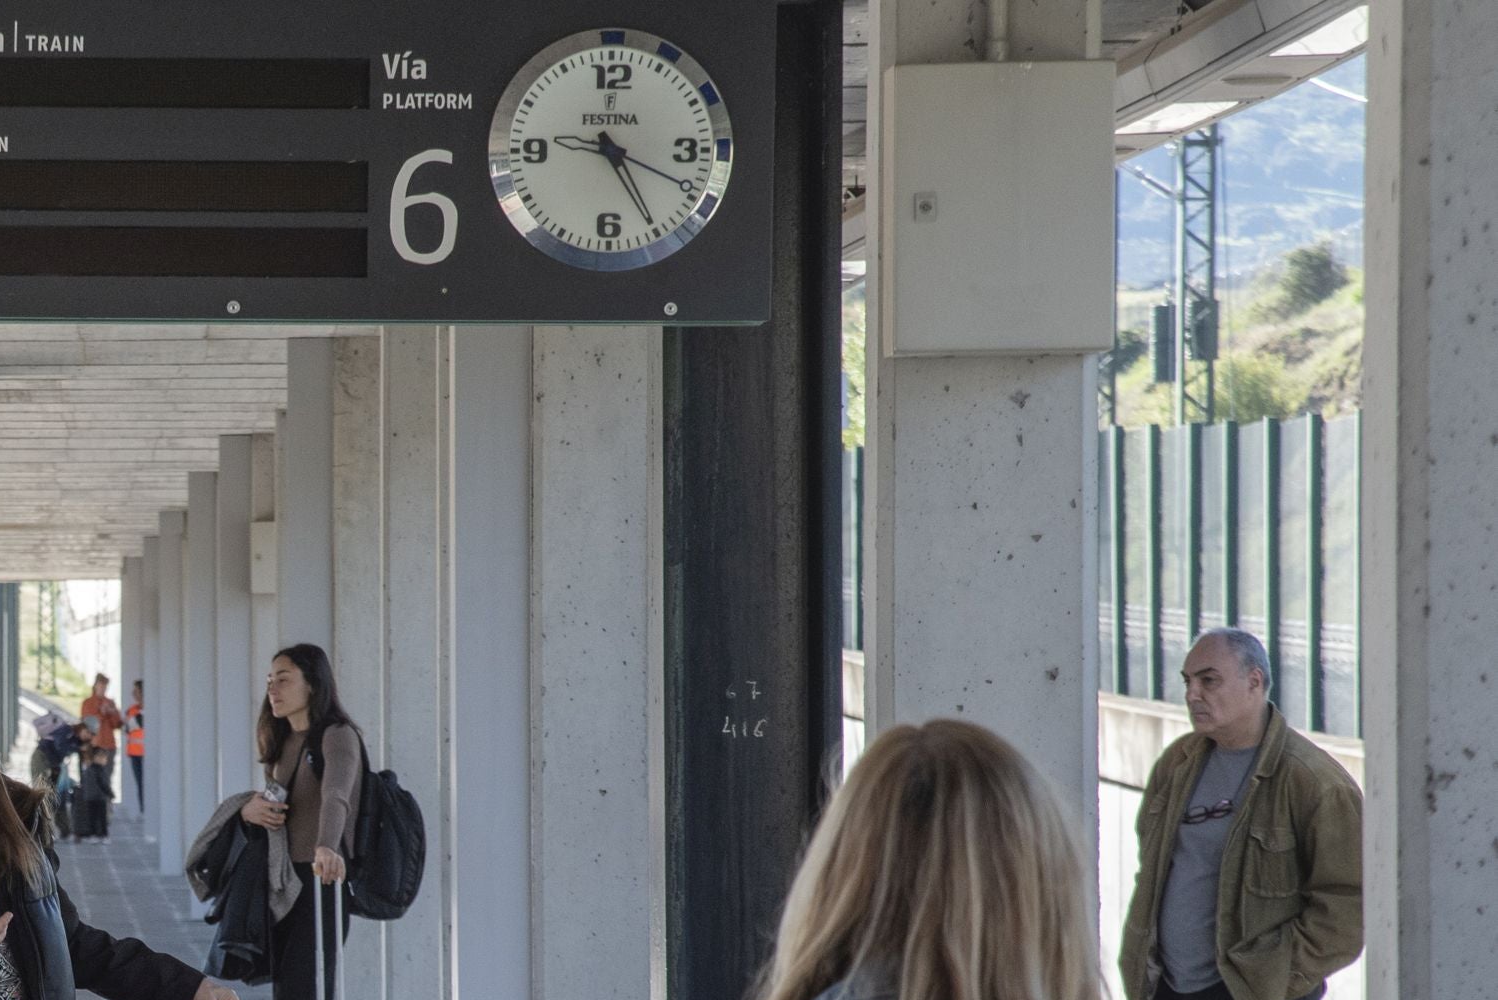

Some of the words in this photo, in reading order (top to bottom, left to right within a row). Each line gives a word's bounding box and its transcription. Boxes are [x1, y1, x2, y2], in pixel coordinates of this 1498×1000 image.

[25, 34, 84, 52] TRAIN
[382, 50, 428, 80] Vía
[591, 64, 632, 90] 12
[382, 92, 473, 110] PLATFORM
[582, 113, 639, 126] FESTINA
[522, 138, 548, 164] 9
[672, 137, 698, 163] 3
[389, 148, 459, 265] 6
[596, 212, 622, 239] 6
